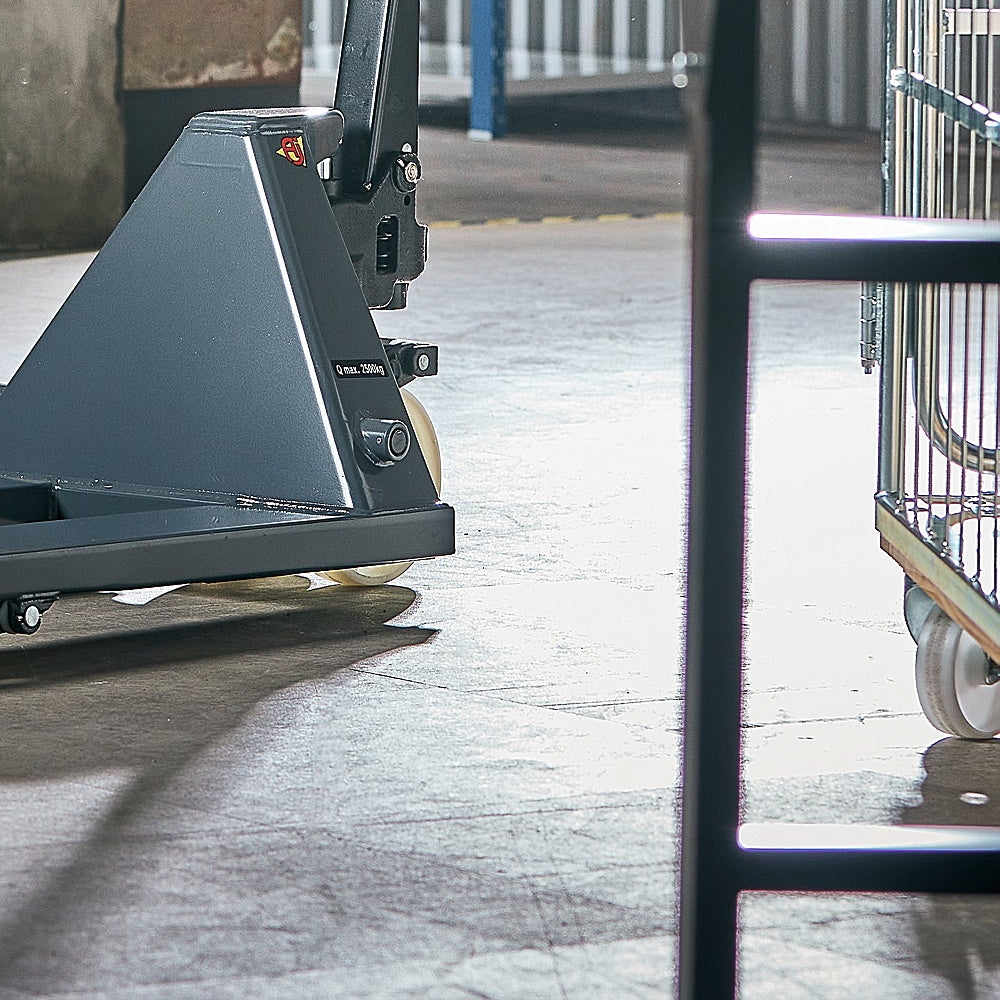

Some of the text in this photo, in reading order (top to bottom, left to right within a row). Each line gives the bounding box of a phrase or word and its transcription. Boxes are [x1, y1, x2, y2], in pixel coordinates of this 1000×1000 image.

[335, 363, 385, 376] Q max. 2500kg
